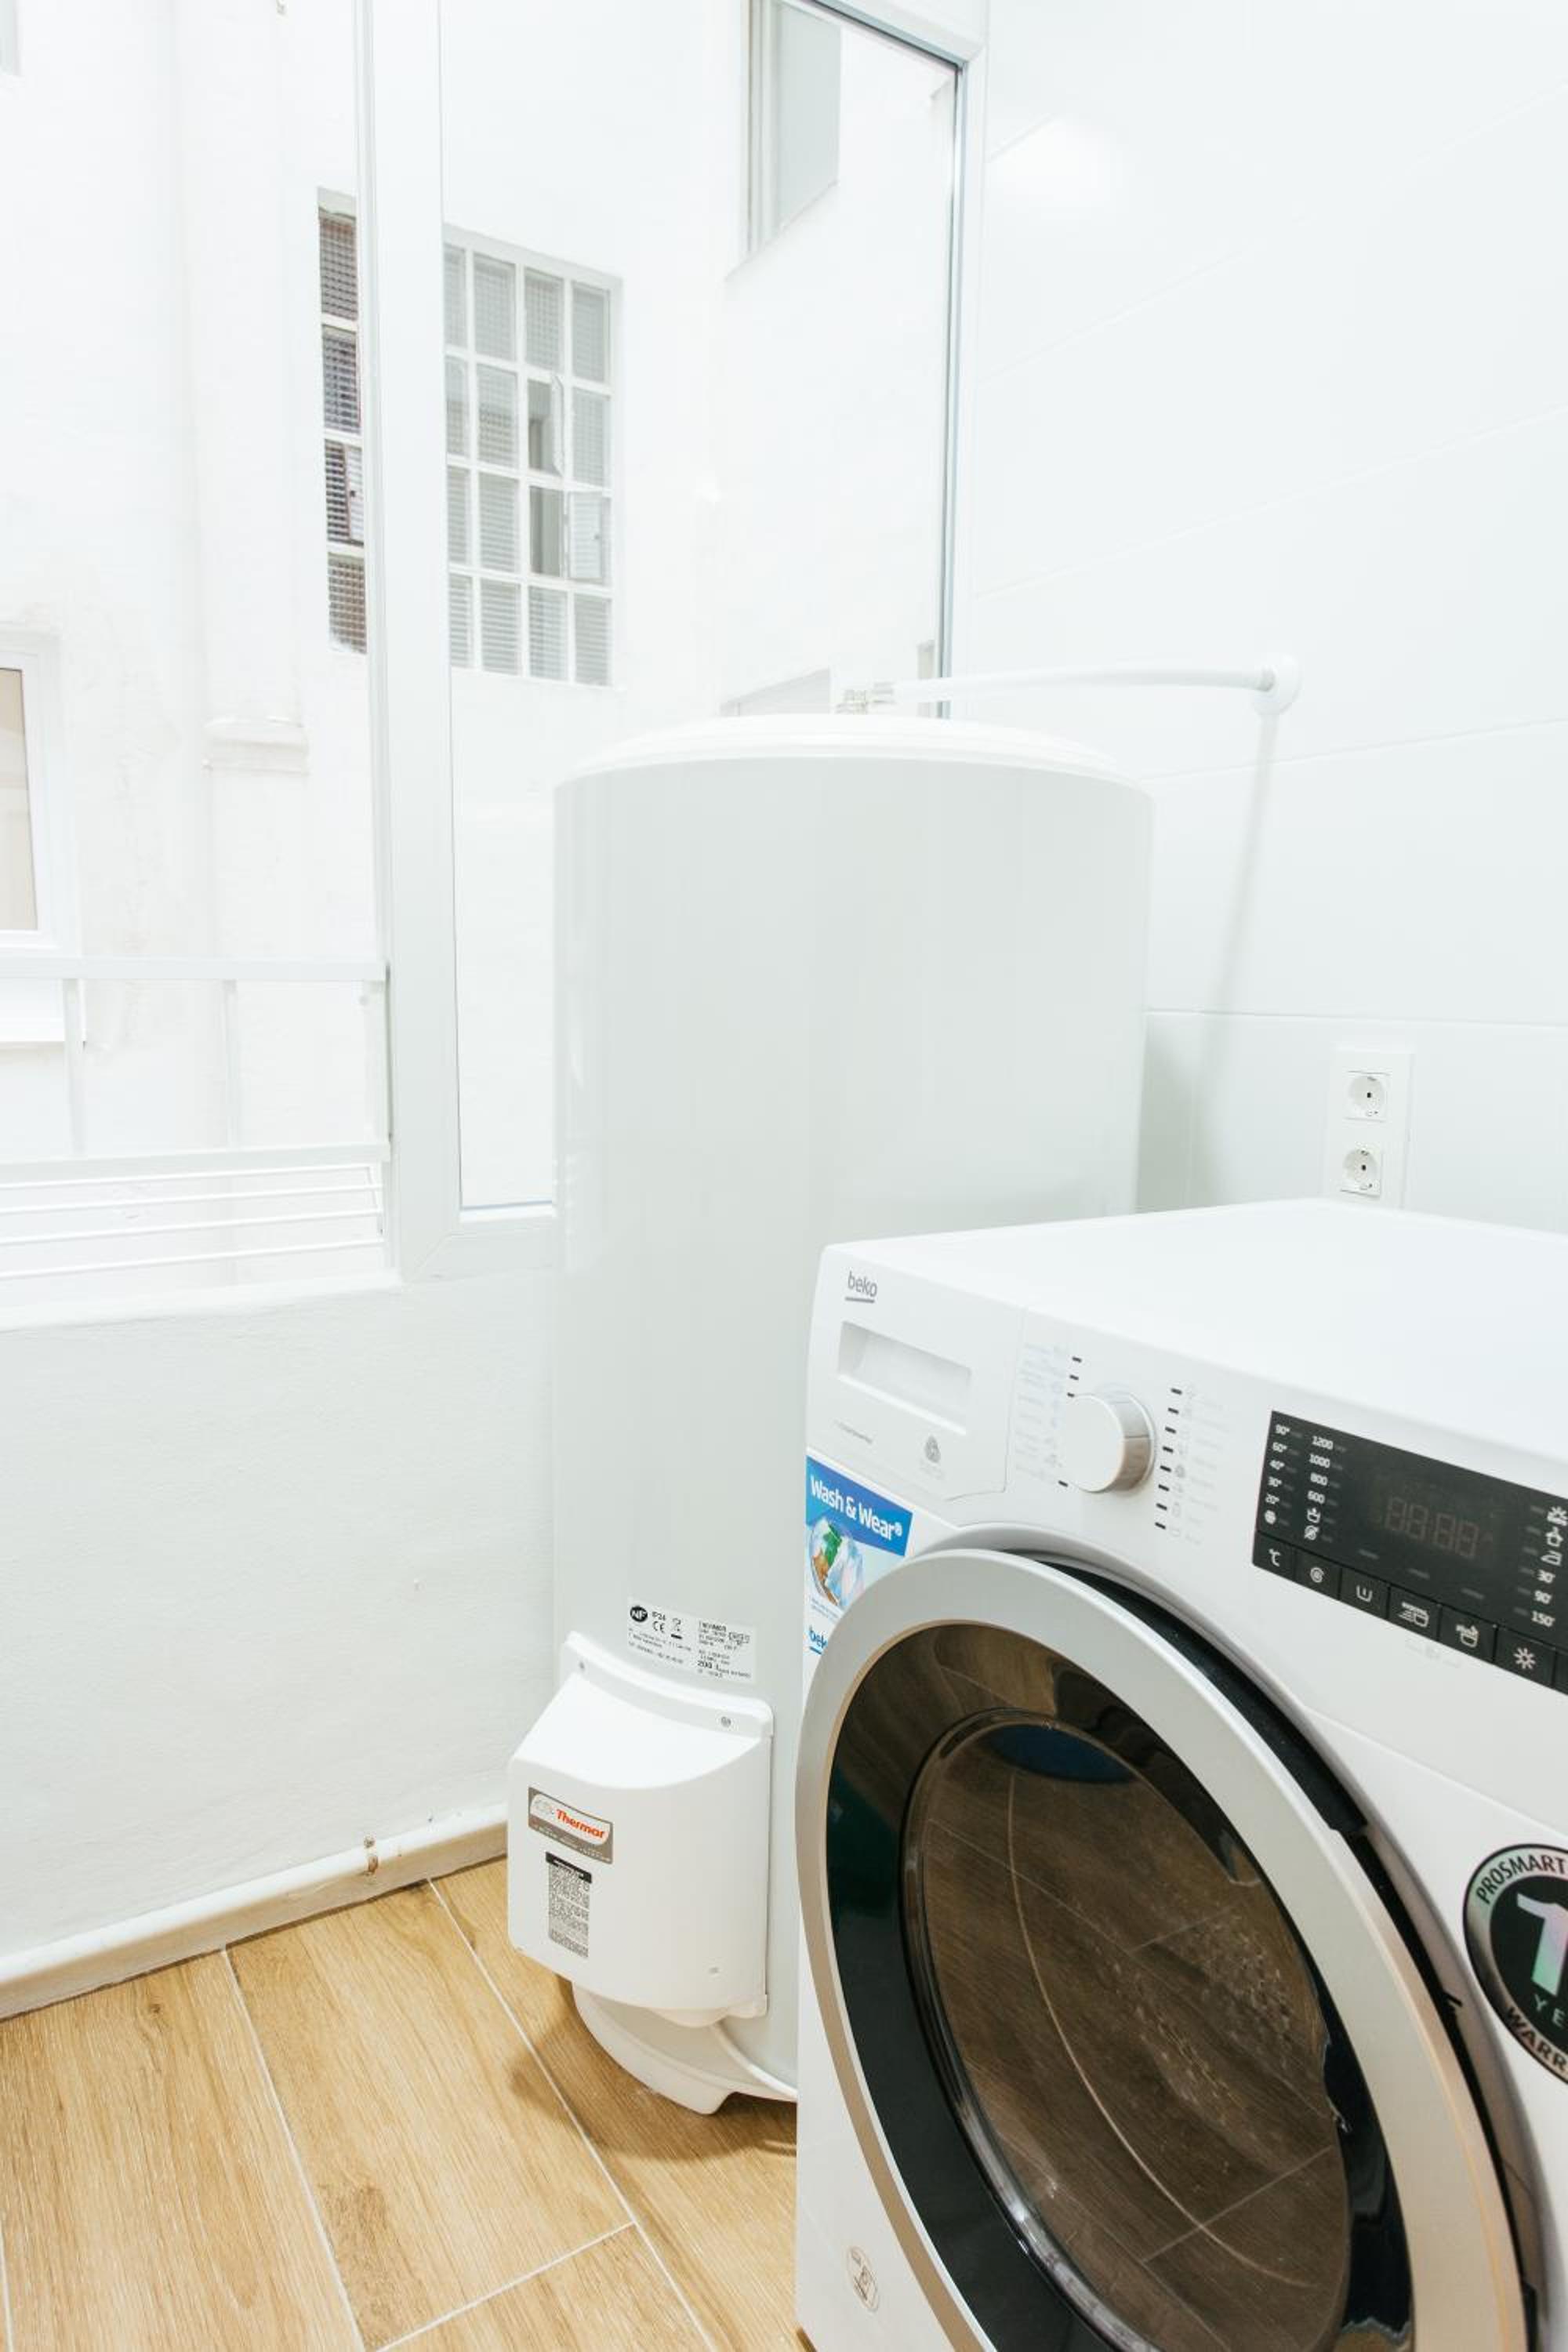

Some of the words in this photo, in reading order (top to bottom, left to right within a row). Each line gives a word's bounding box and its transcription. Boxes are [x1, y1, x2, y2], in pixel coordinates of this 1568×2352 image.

[847, 1270, 878, 1298] beko
[1312, 1436, 1334, 1450] 1200
[1308, 1453, 1330, 1468] 1000
[1310, 1472, 1328, 1486] 800
[810, 1475, 844, 1513] Wash
[846, 1495, 857, 1520] &
[652, 1621, 665, 1633] CE
[809, 1624, 828, 1649] bek
[1475, 1854, 1566, 1905] PROSMART
[1533, 1994, 1567, 2029] YE
[1507, 2005, 1568, 2074] WARR
